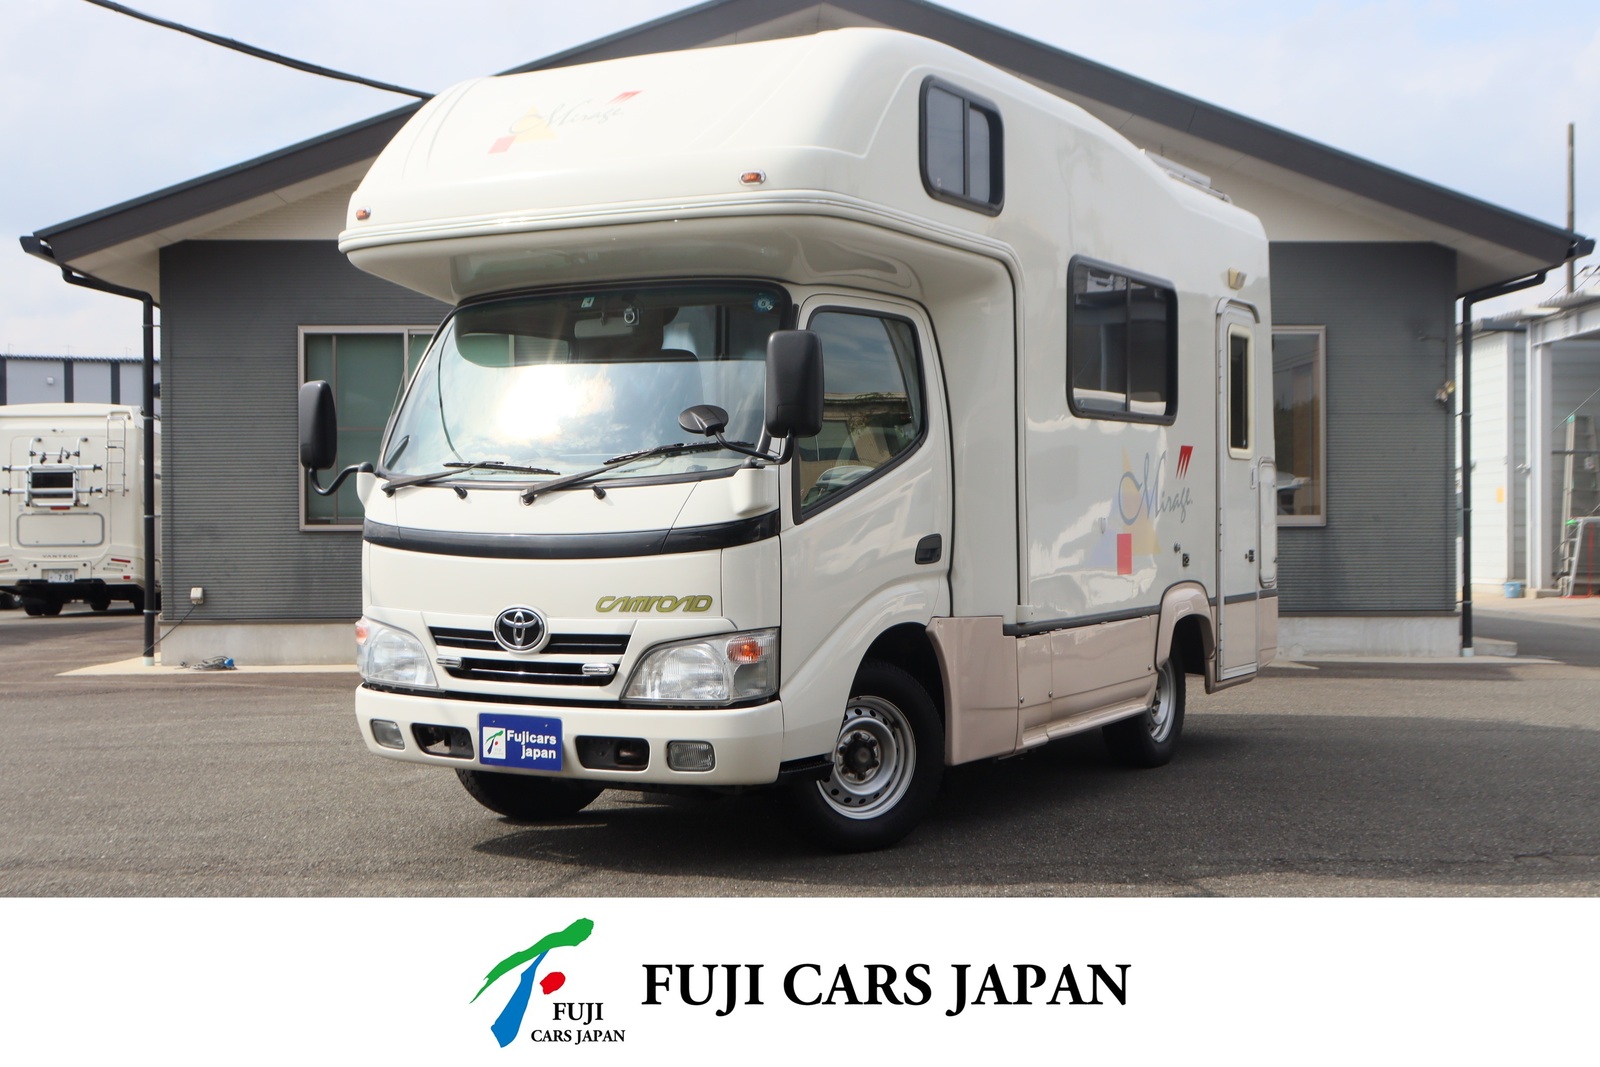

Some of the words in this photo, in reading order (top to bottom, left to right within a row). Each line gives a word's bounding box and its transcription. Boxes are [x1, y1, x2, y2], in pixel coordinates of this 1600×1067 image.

[596, 595, 713, 613] CAMROAD
[506, 729, 557, 745] Fujicars
[521, 745, 557, 760] japan
